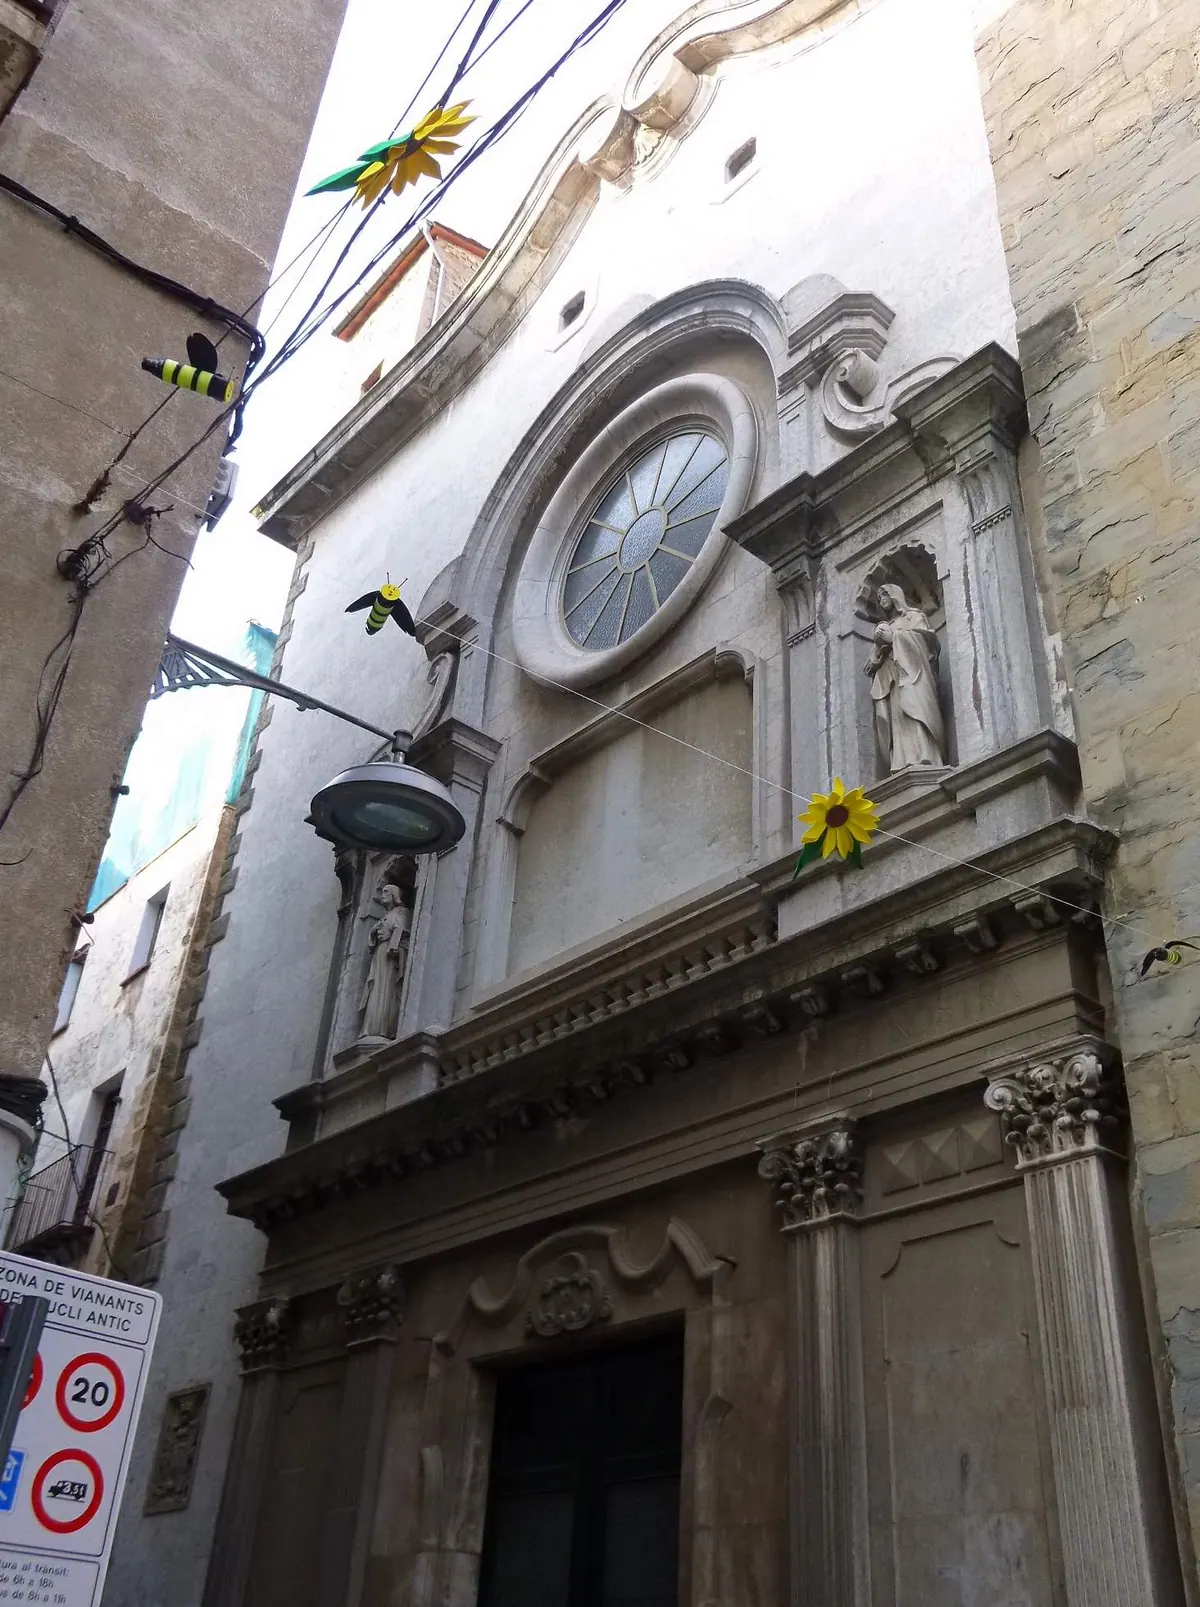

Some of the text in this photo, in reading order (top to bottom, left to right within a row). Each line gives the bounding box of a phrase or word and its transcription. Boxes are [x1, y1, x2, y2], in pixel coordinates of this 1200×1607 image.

[0, 1266, 145, 1316] ZONA DE VIANANTS
[48, 1301, 82, 1321] UCLI
[86, 1311, 132, 1333] ANTIC
[71, 1377, 109, 1407] 20
[21, 1561, 32, 1572] al
[11, 1589, 25, 1600] de
